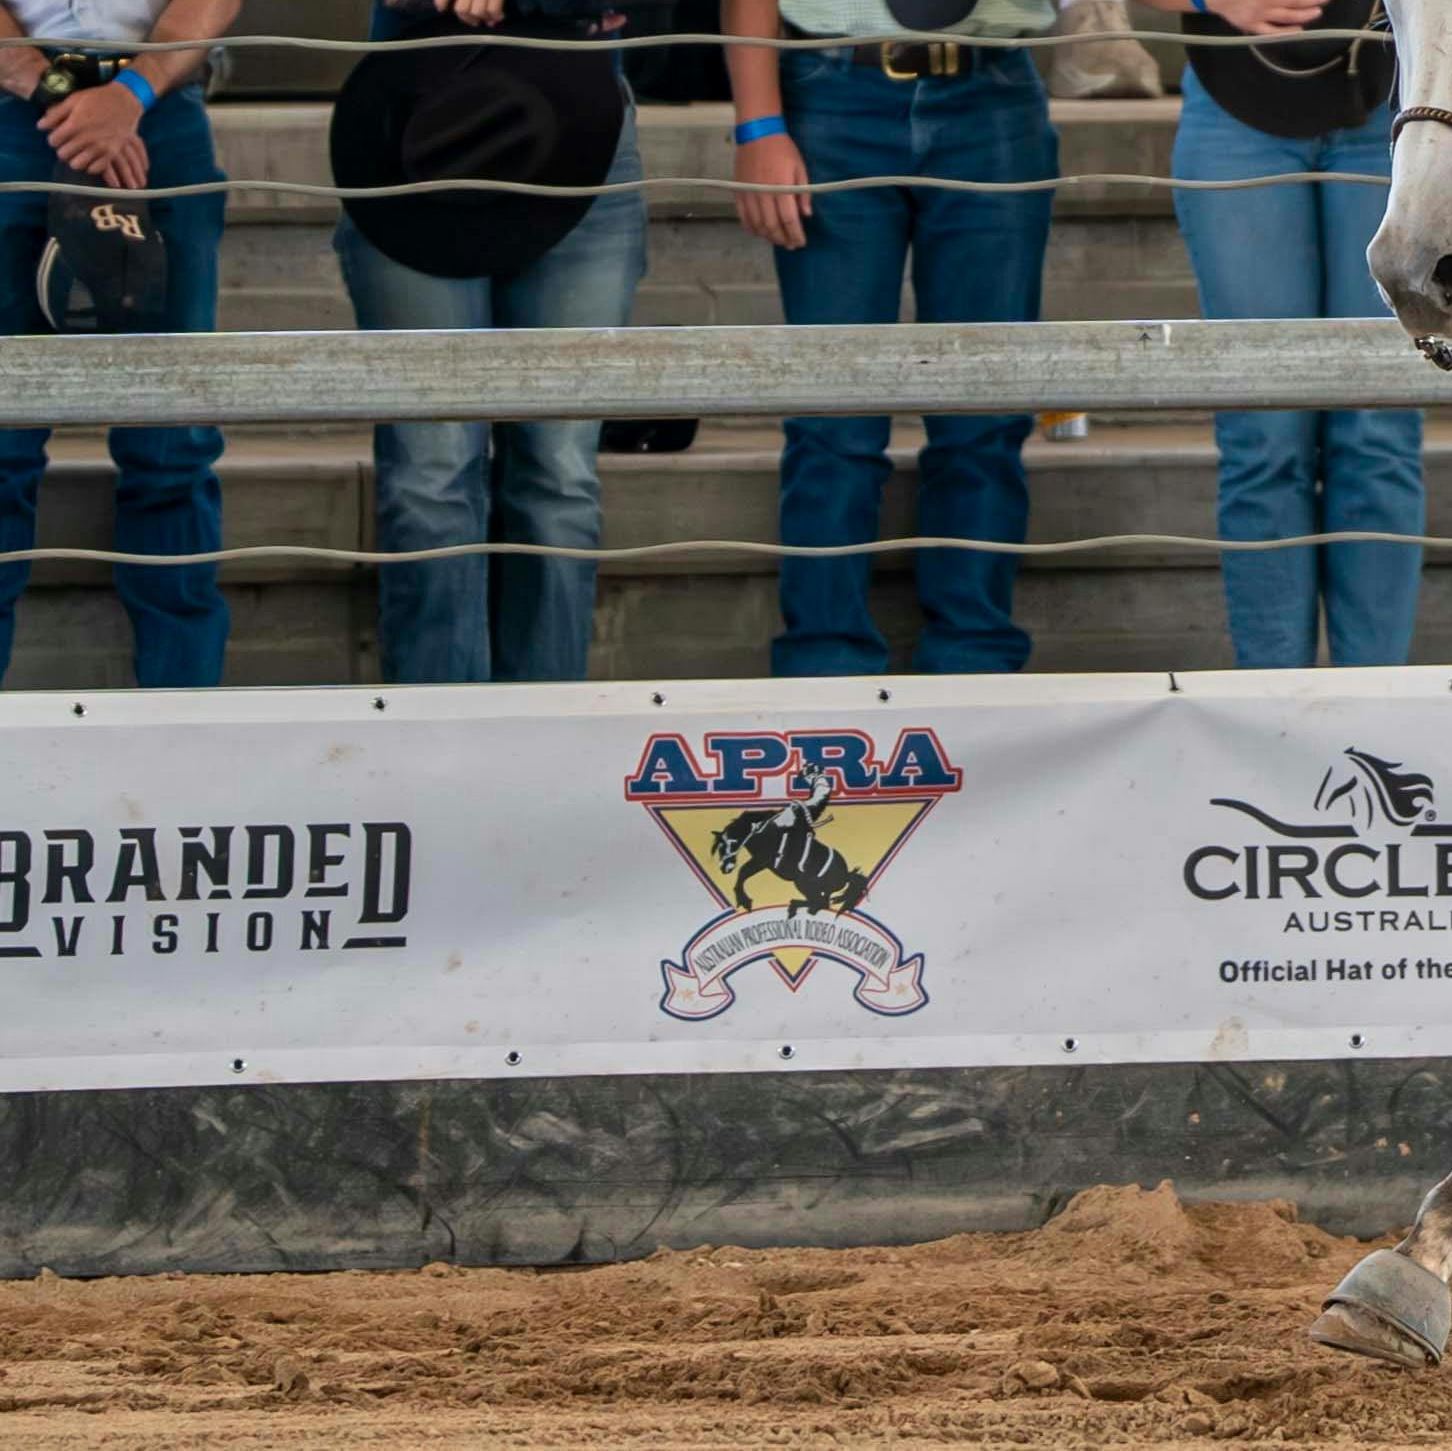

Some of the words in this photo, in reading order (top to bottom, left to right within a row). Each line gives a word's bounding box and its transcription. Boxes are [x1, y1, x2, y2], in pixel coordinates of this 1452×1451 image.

[624, 727, 963, 801] APRA
[0, 822, 412, 932] BRANDED
[52, 909, 332, 957] VISION
[693, 931, 746, 975] AUSTRALIAN
[741, 919, 802, 949] PROFESSIONAL
[804, 919, 836, 943] RODEO
[835, 928, 890, 969] ASSOCIATION
[1219, 959, 1317, 983] Official
[1326, 958, 1373, 981] Hat
[1382, 957, 1408, 981] of
